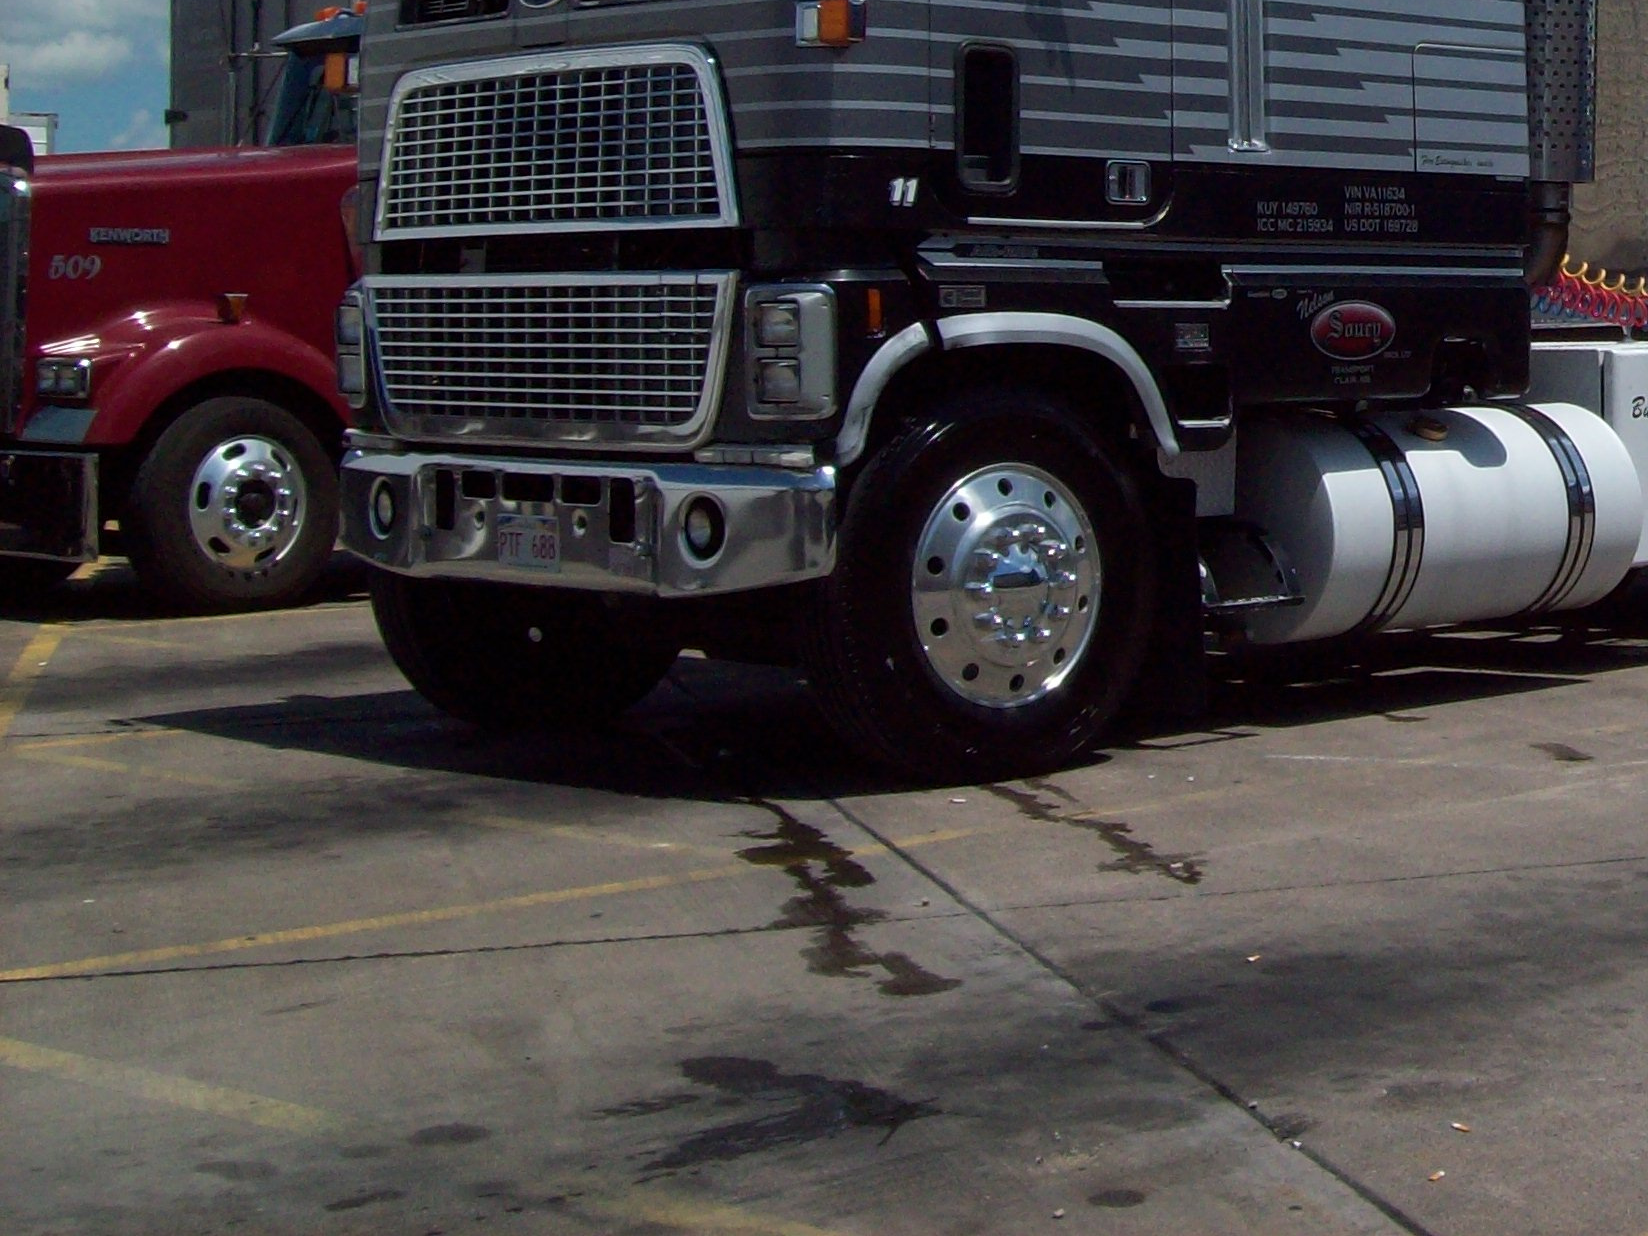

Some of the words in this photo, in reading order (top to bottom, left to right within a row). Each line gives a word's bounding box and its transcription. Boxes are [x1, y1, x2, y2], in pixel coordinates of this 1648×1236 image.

[889, 177, 919, 207] 11
[1344, 185, 1362, 199] VIN
[1363, 186, 1406, 200] VA11634
[1256, 201, 1278, 215] KUY
[1344, 202, 1362, 215] NIR
[1257, 218, 1275, 232] ICC
[1277, 219, 1294, 232] MC
[1296, 219, 1334, 232] 215934
[1344, 218, 1358, 231] US
[1359, 219, 1380, 232] DOT
[89, 227, 170, 243] KENWORTH
[48, 254, 101, 280] 509
[1296, 290, 1335, 320] Nelson
[1326, 310, 1381, 345] Soucy
